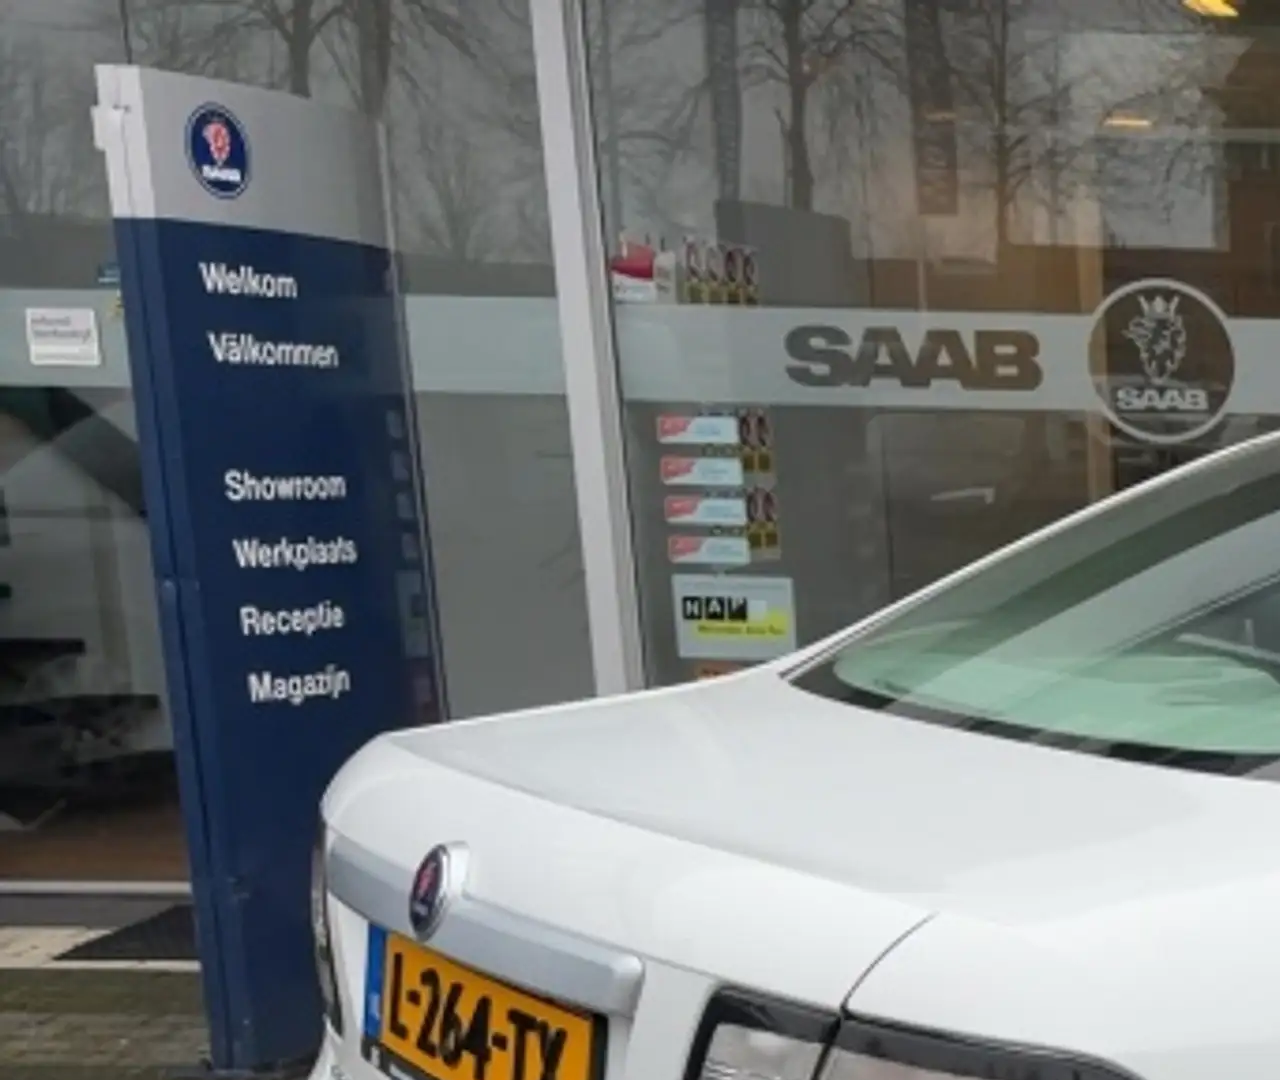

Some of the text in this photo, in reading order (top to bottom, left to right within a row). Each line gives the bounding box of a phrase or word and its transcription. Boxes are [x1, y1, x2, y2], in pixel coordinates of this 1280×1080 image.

[199, 262, 298, 298] Welkom
[207, 330, 340, 369] Välkommen
[784, 325, 1043, 391] SAAB
[1116, 387, 1209, 411] SAAB
[224, 468, 347, 502] Showroom
[232, 536, 358, 572] Werkplaats
[239, 600, 345, 637] Receptie
[248, 663, 351, 706] Magazijn
